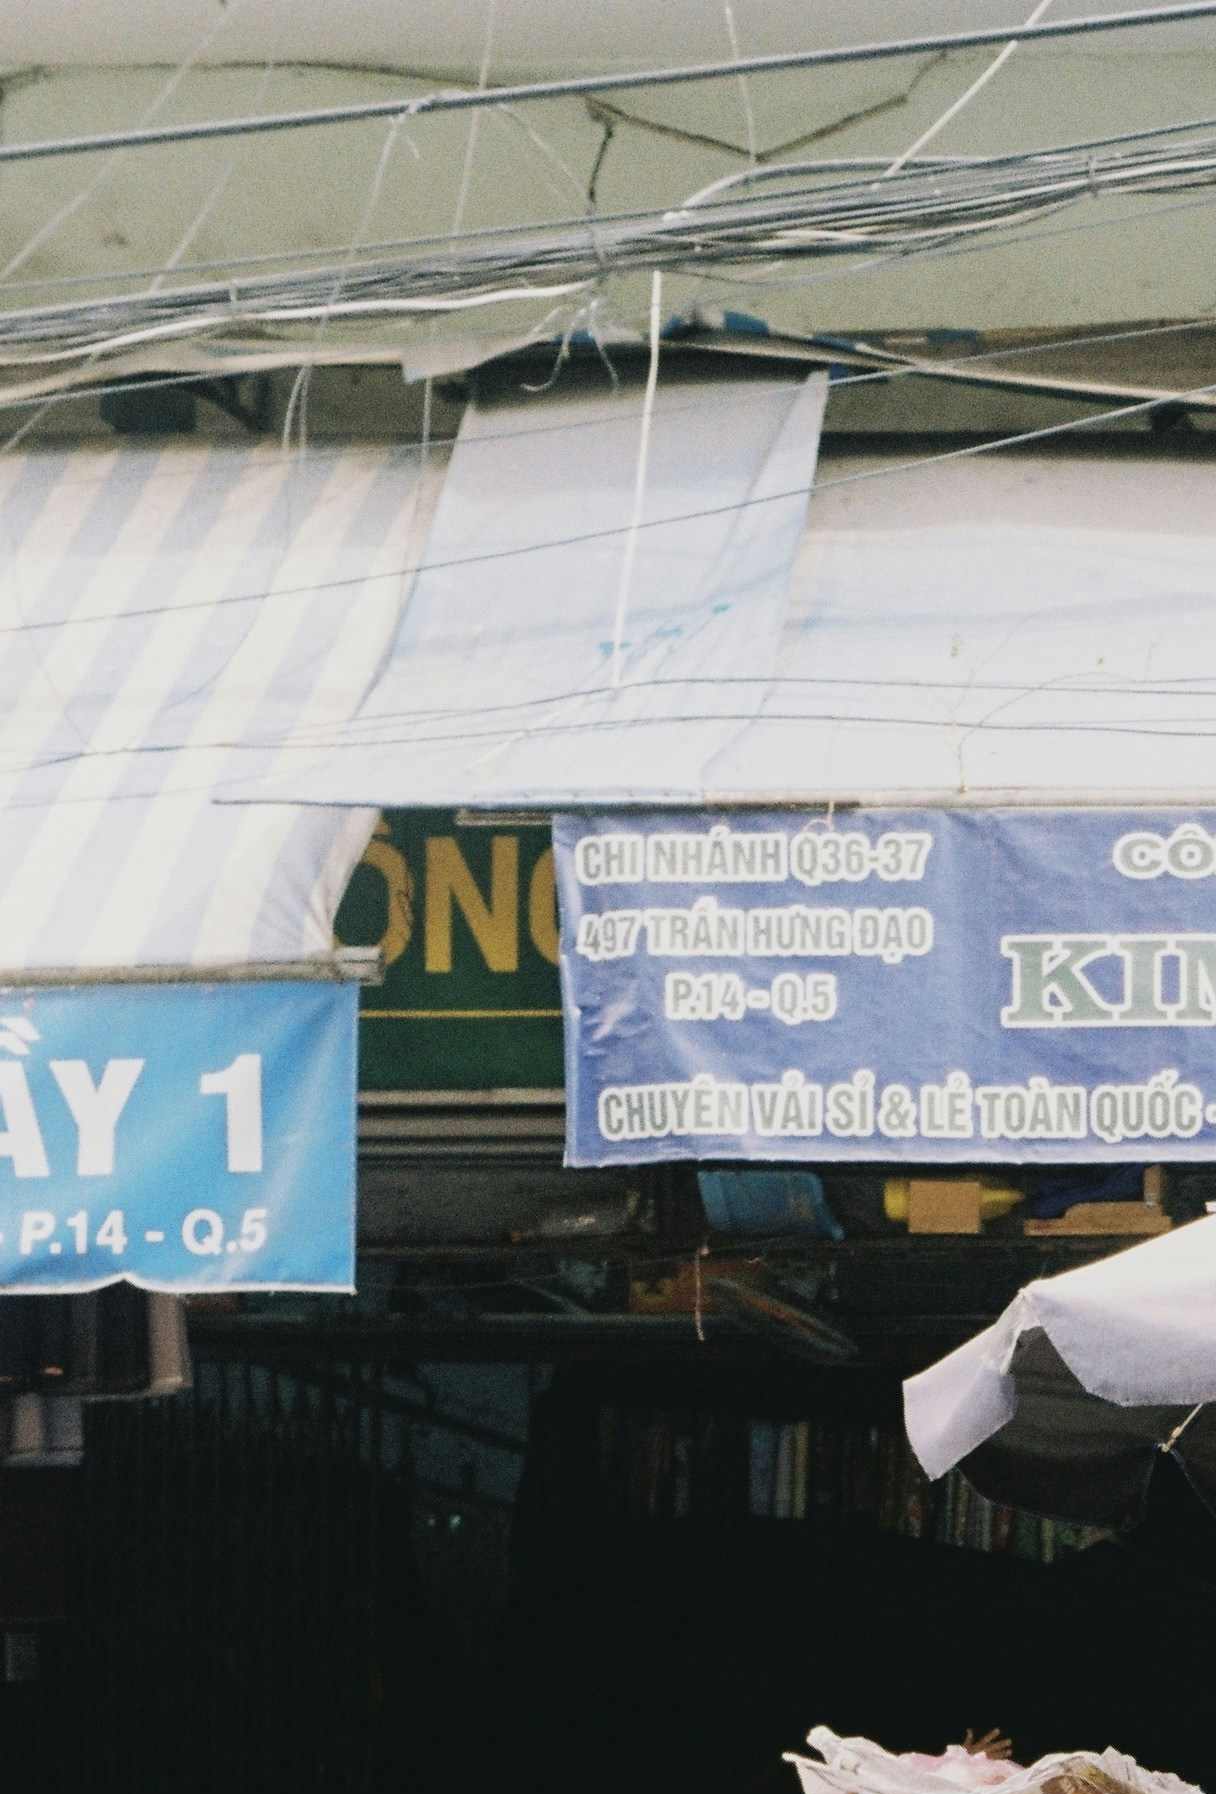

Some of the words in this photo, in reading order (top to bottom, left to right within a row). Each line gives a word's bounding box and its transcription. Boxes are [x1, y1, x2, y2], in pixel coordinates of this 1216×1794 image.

[579, 837, 643, 884] CHI
[649, 828, 788, 880] NHÁNH
[793, 833, 931, 882] Q36-37
[578, 912, 641, 958] 497
[749, 906, 849, 953] HƯNG
[854, 910, 931, 961] ĐẠO
[667, 975, 744, 1018] P.14
[774, 975, 835, 1023] Q.5
[200, 1053, 262, 1173] 1
[602, 1076, 747, 1137] CHUYÊN
[753, 1072, 821, 1135] VẢI
[829, 1072, 874, 1135] SỈ
[881, 1087, 915, 1136] &
[923, 1073, 972, 1136] LẺ
[978, 1080, 1086, 1137] TOÀN
[1094, 1071, 1201, 1141] QUỐC
[19, 1209, 128, 1255] P.14
[144, 1229, 166, 1243] -
[181, 1207, 268, 1256] Q.5
